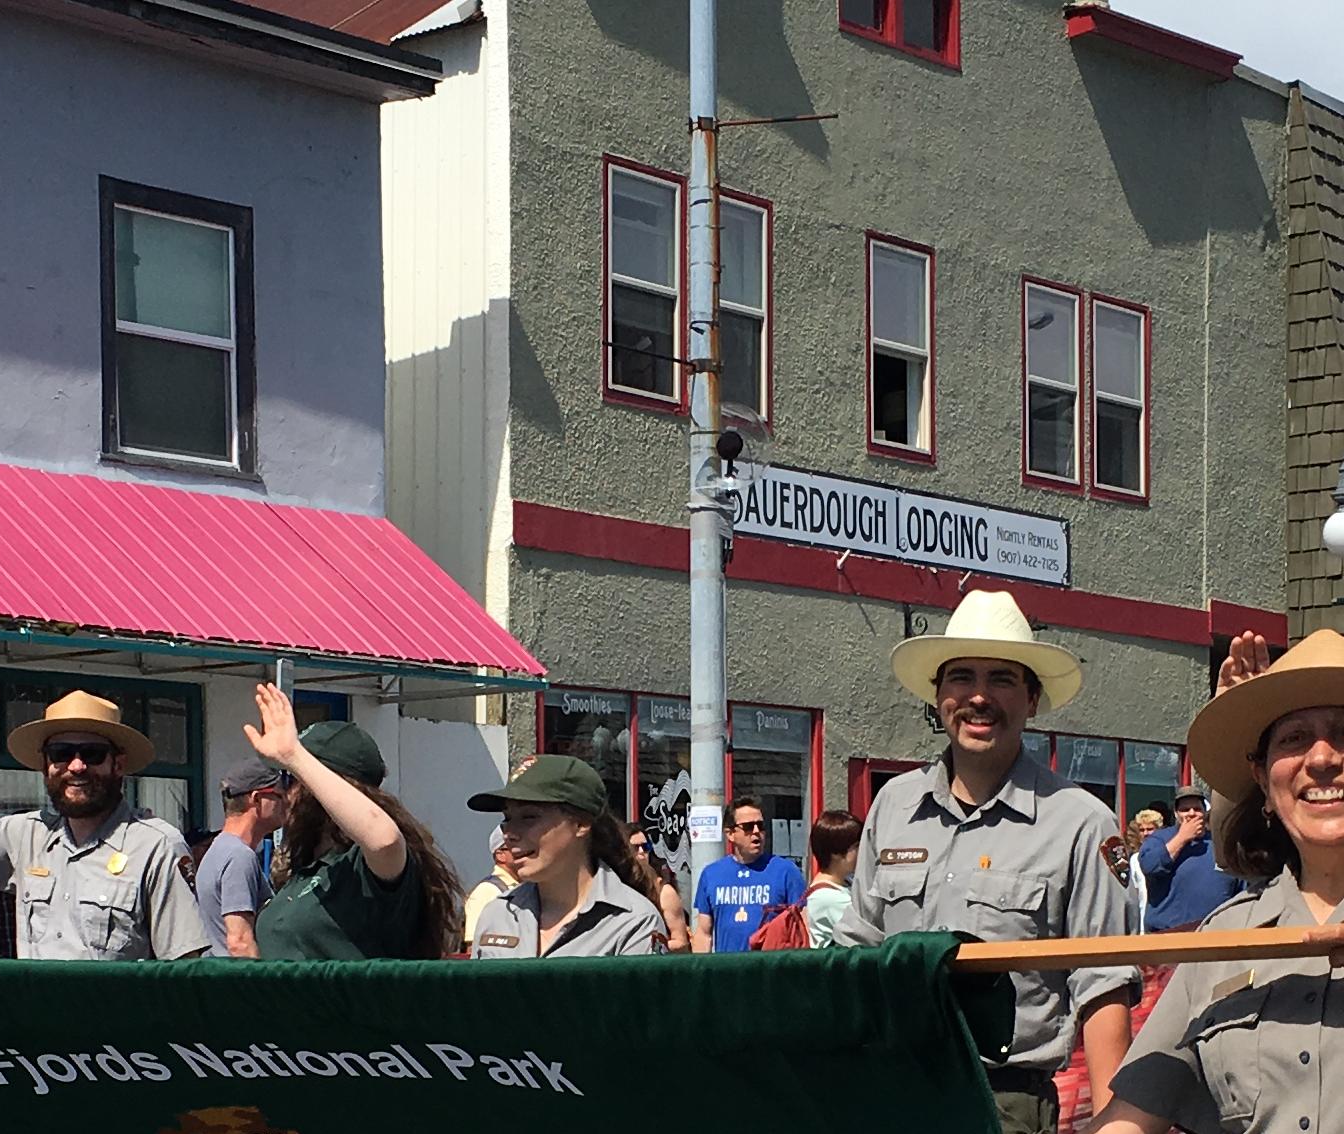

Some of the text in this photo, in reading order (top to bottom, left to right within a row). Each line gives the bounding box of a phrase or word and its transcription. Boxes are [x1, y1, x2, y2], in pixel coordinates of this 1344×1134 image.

[997, 548, 1021, 565] (907)
[561, 692, 612, 716] Smoothies
[650, 700, 691, 724] Loose-lea
[755, 711, 789, 732] Paninis
[715, 884, 771, 906] MARINERS
[168, 1042, 433, 1080] National
[425, 1043, 585, 1097] Park
